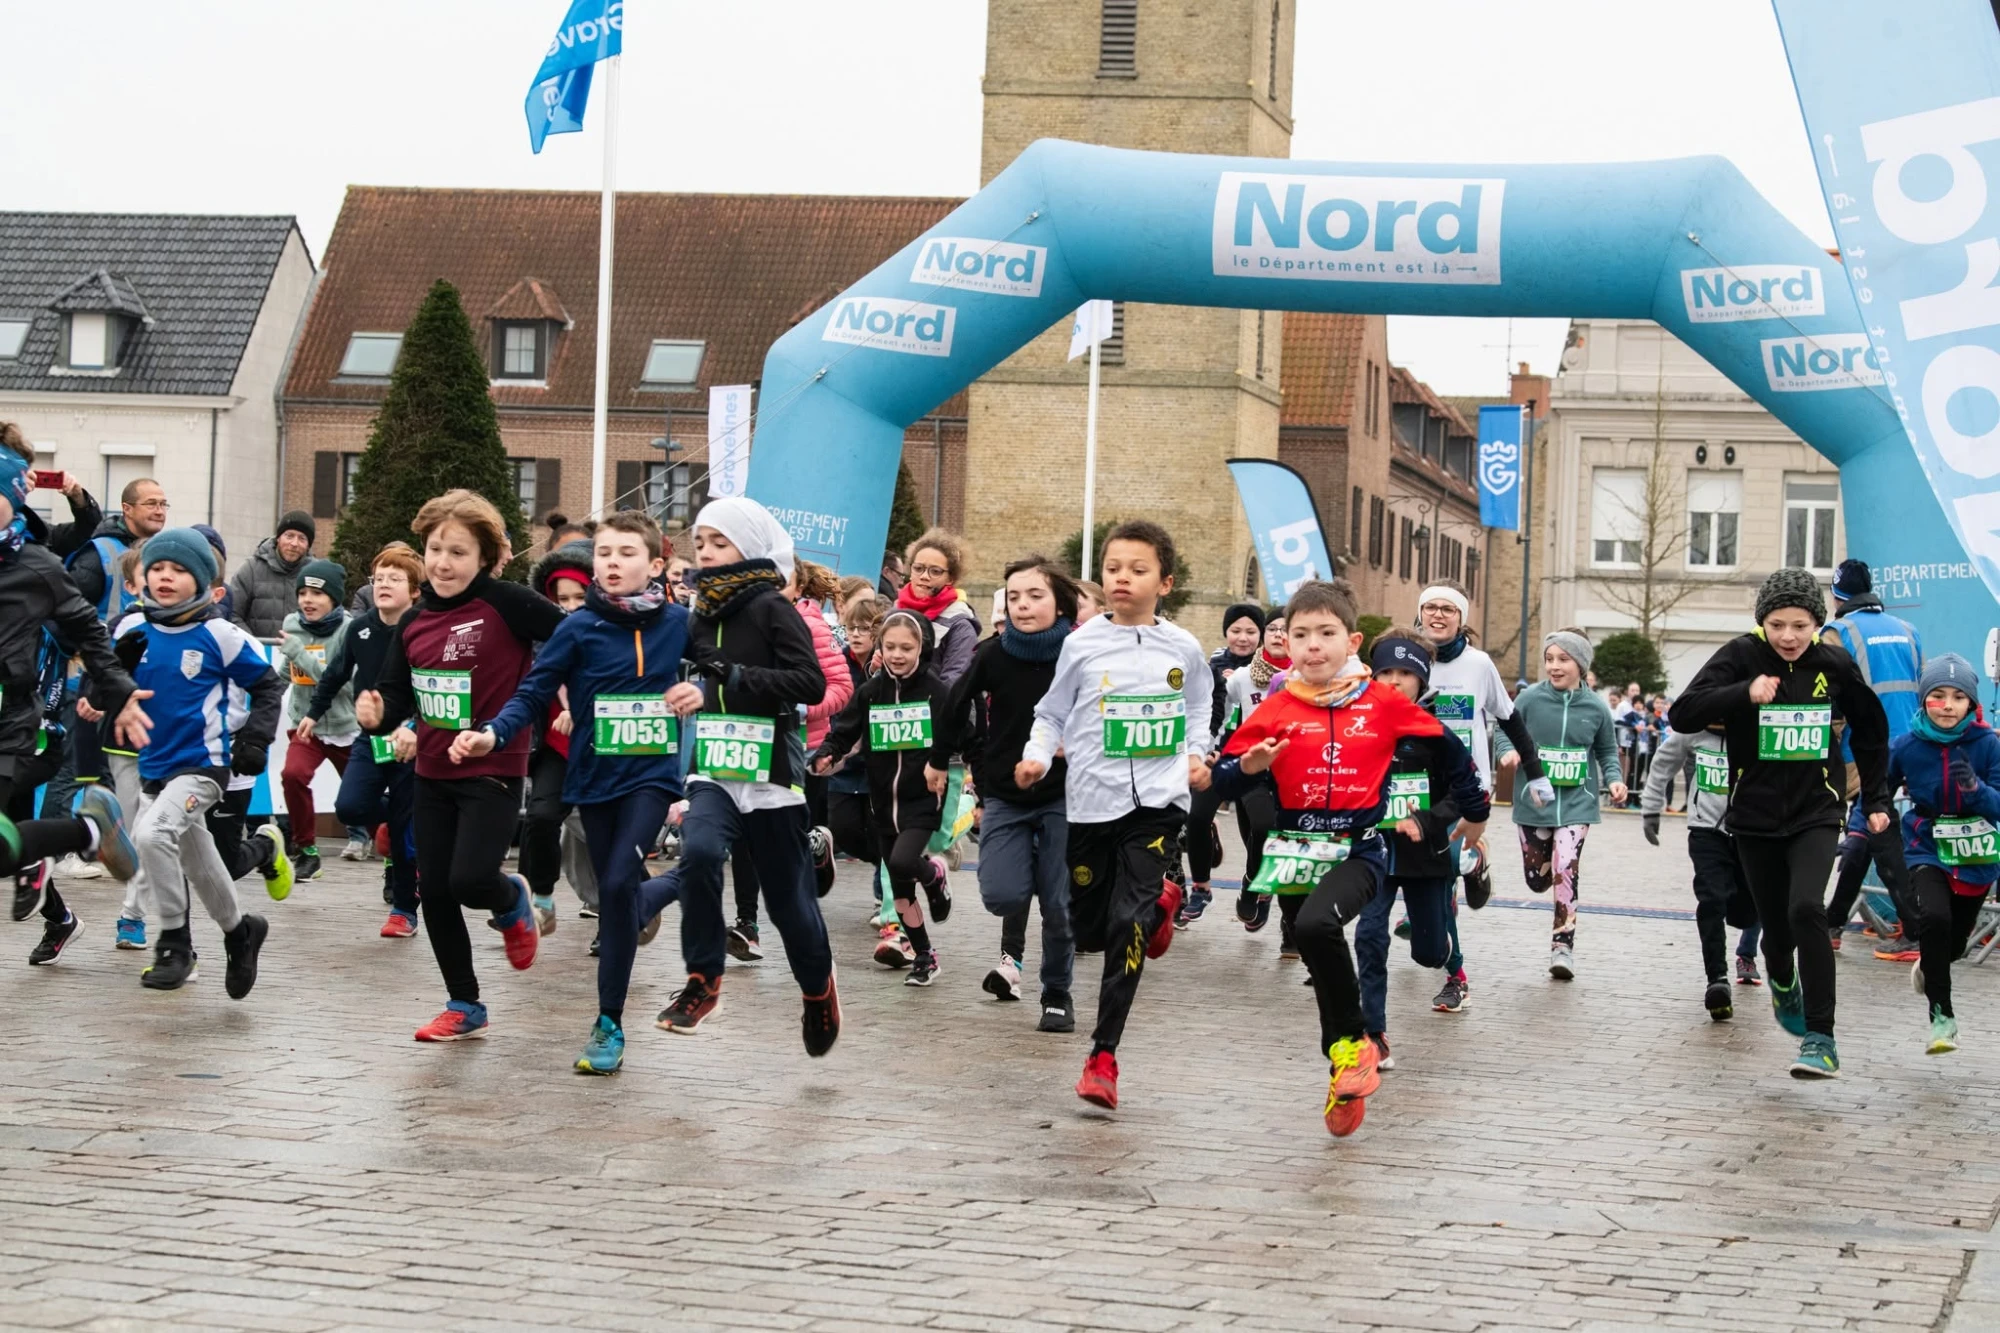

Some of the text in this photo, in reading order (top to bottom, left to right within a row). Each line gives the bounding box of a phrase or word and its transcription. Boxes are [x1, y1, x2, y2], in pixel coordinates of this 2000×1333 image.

[1234, 182, 1482, 254] Nord
[923, 243, 1036, 283] Nord
[1234, 255, 1450, 274] le Département est là
[931, 273, 988, 288] Département
[1691, 270, 1813, 309] Nord
[835, 302, 946, 343] Nord
[719, 392, 737, 494] Gravelines
[767, 506, 849, 532] PARTEMENT
[788, 525, 814, 542] EST
[1883, 563, 1978, 583] DÉPARTEMEN
[1871, 584, 1887, 599] ST
[416, 690, 460, 720] 7009
[609, 719, 668, 744] 7053
[880, 721, 924, 743] 7024
[1122, 720, 1175, 748] 7017
[1773, 727, 1822, 751] 7049
[704, 740, 760, 771] 7036
[1547, 762, 1581, 780] 7007
[1703, 767, 1729, 787] 702
[1946, 834, 1998, 858] 7042
